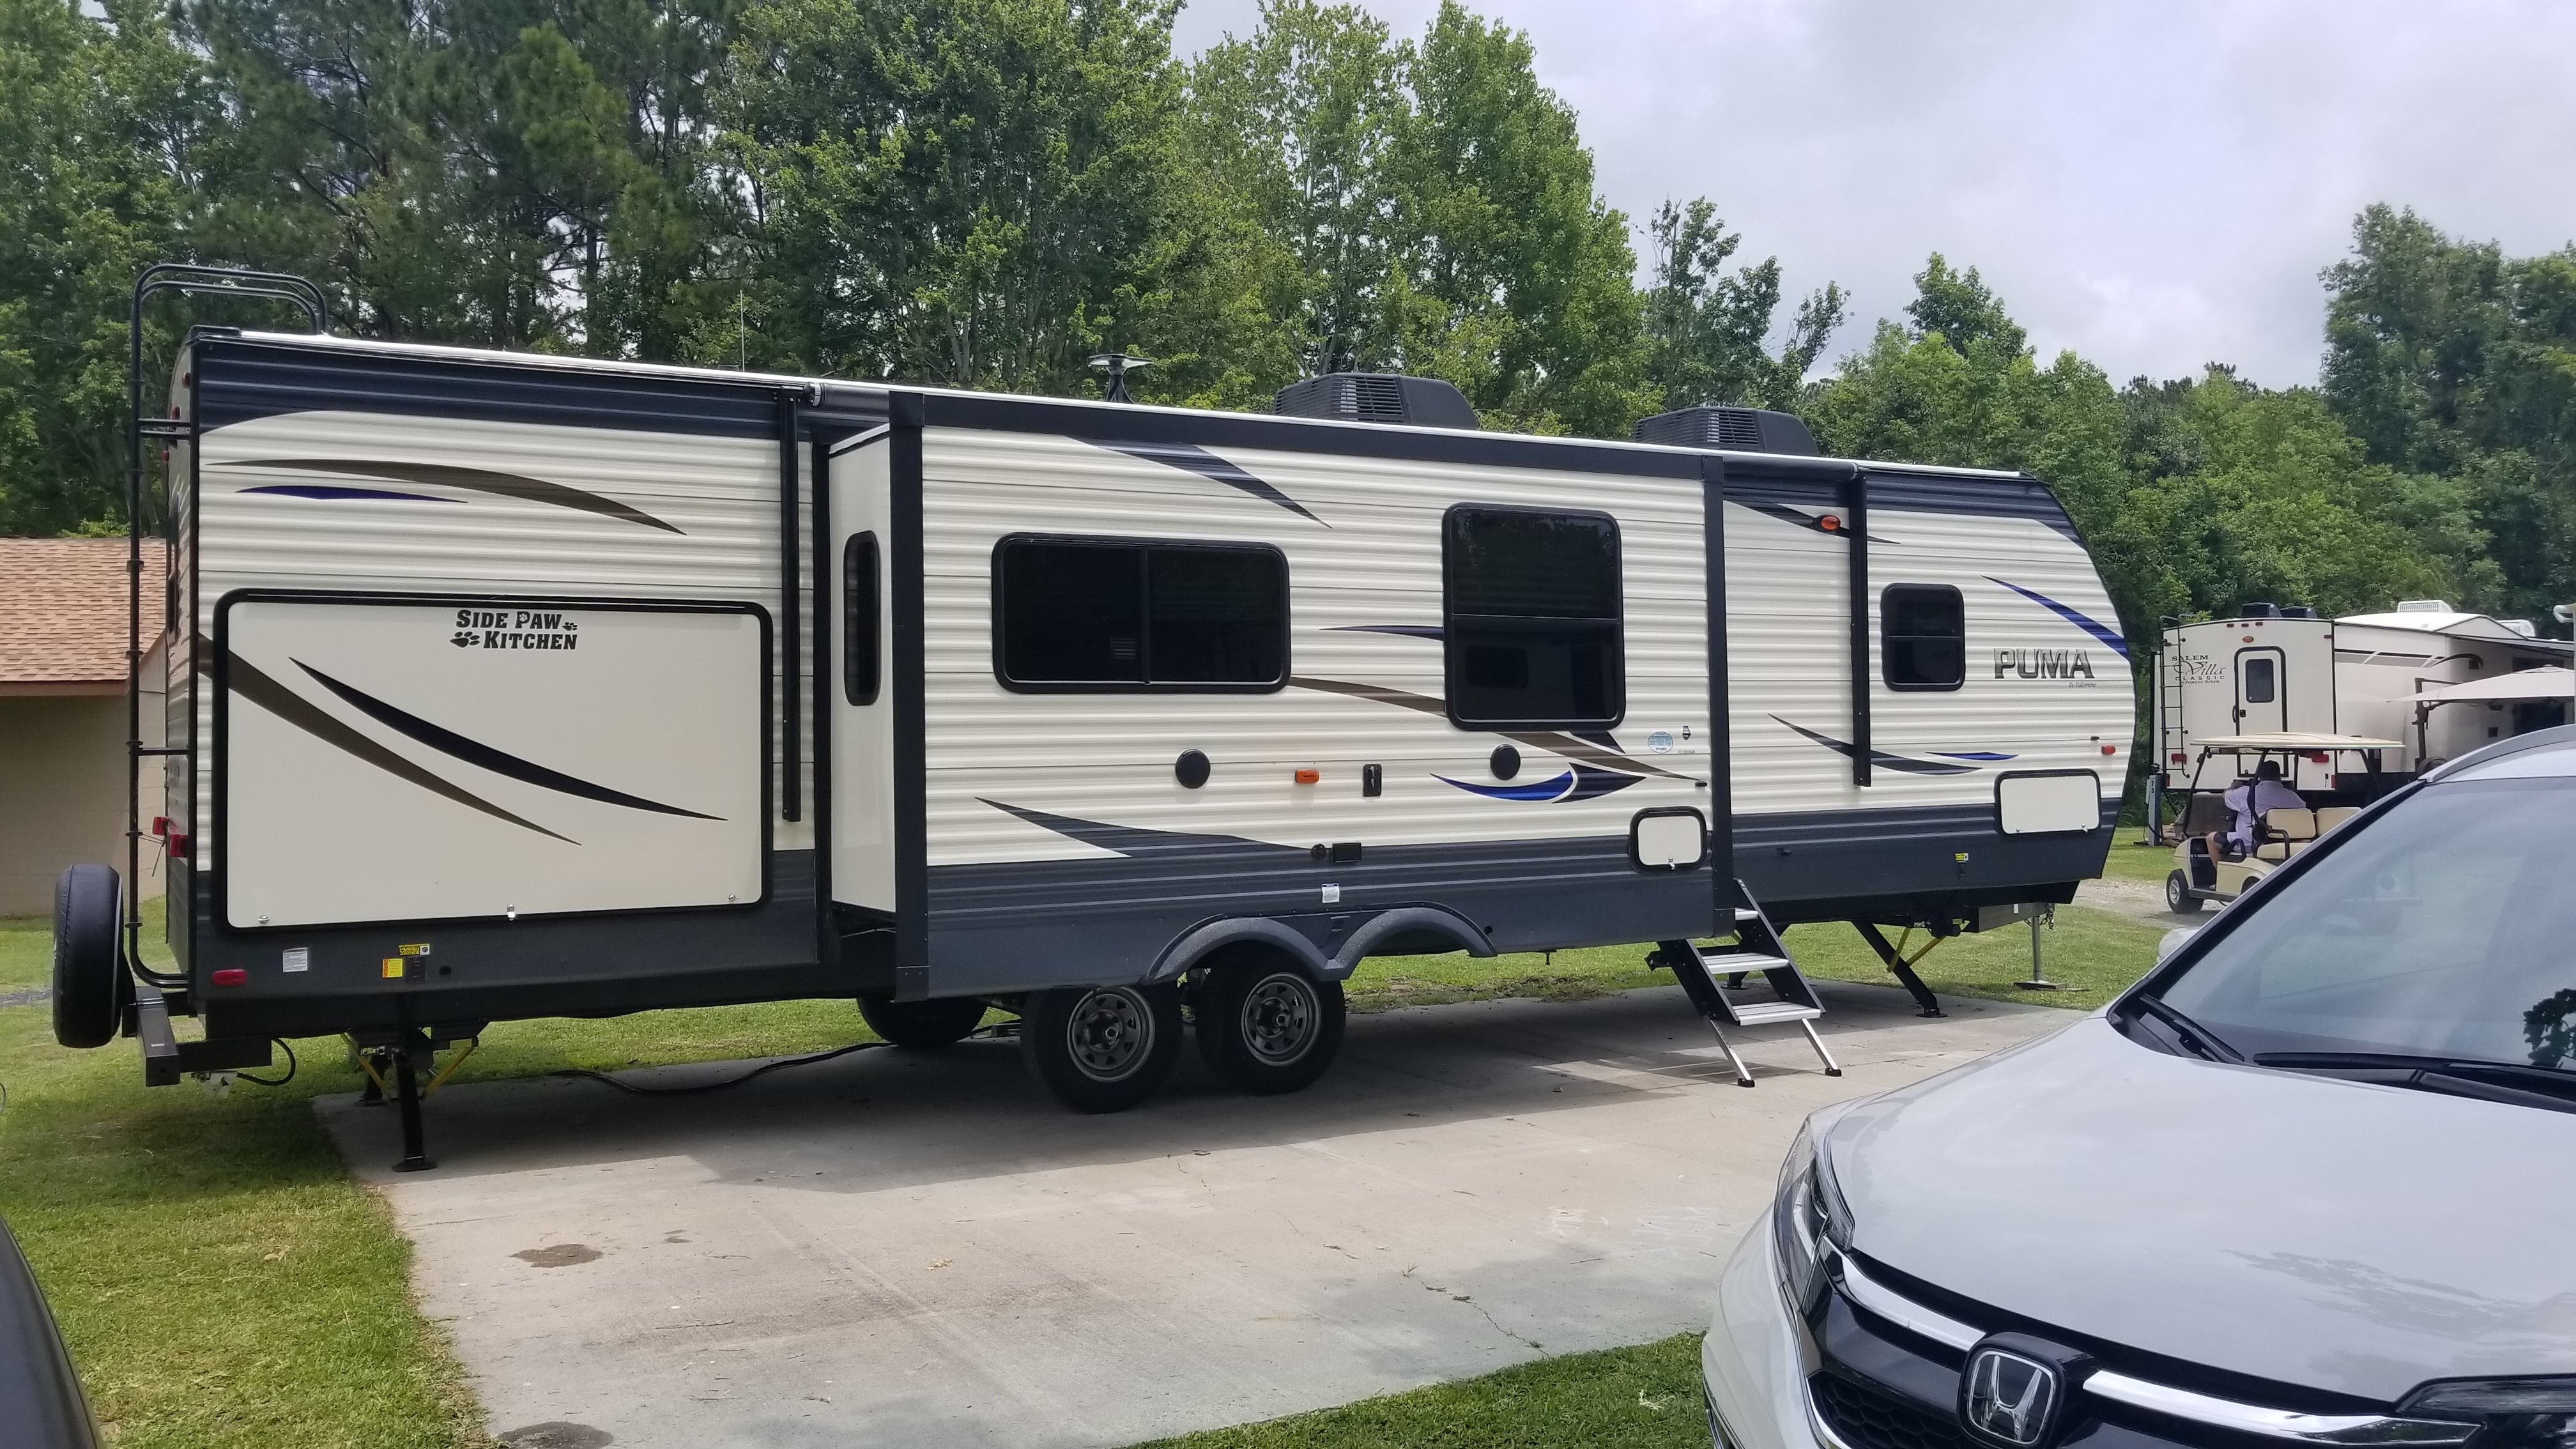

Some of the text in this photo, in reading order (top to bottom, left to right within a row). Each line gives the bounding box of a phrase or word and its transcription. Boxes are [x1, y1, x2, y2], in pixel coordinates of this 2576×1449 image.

[456, 610, 562, 629] SIDE PAW
[483, 631, 578, 650] KITCHEN
[1993, 648, 2095, 679] PUMA
[2174, 661, 2226, 675] Villa
